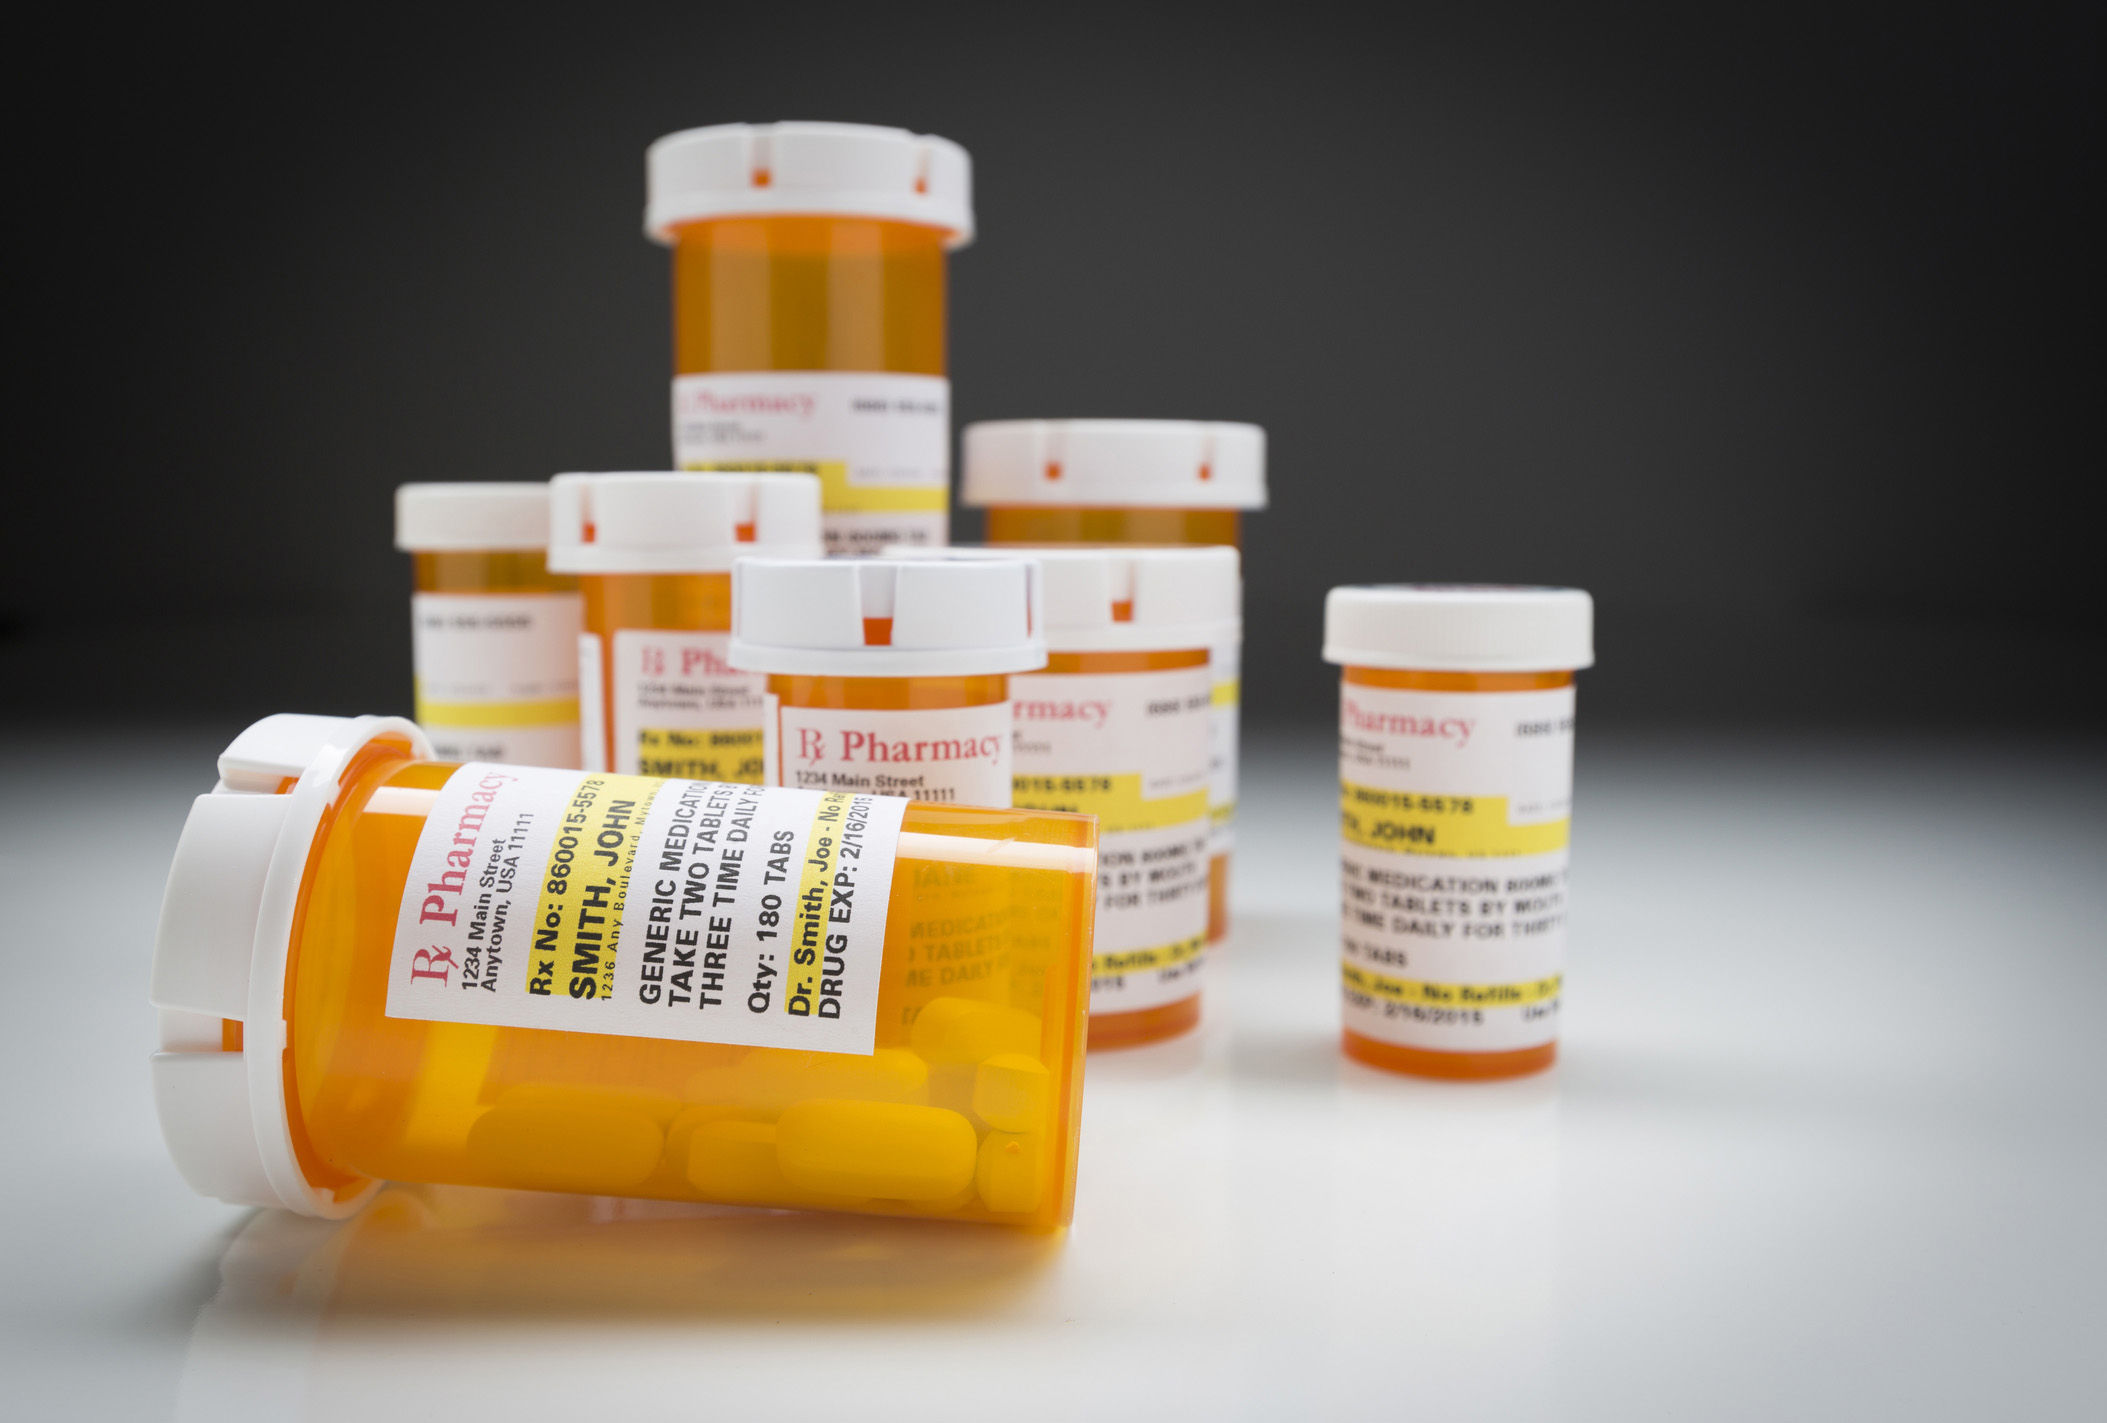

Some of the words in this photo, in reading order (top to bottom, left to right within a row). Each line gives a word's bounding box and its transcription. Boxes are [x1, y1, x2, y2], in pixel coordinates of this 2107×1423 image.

[840, 730, 1002, 765] Pharmacy
[796, 770, 827, 784] 1234
[832, 773, 870, 787] Main
[876, 774, 924, 788] Street
[546, 779, 606, 896] 860015-5578
[692, 790, 734, 854] TABLETS
[727, 798, 760, 842] DAILY
[818, 805, 842, 822] No
[840, 797, 874, 860] 2/16/2015
[1371, 820, 1435, 845] JOHN
[418, 771, 519, 927] Pharmacy
[479, 838, 506, 889] Street
[764, 830, 795, 886] TABS
[808, 838, 833, 873] Joe
[480, 900, 512, 993] Anytown,
[496, 856, 520, 893] USA
[508, 812, 534, 851] 11111
[568, 877, 617, 1000] SMITH,
[594, 799, 636, 867] JOHN
[679, 862, 710, 920] TWO
[712, 848, 744, 908] TIME
[828, 866, 858, 924] EXP:
[1368, 866, 1498, 893] MEDICATION
[468, 892, 492, 941] Main
[534, 902, 564, 952] No:
[606, 921, 625, 952] Any
[639, 879, 677, 1005] GENERIC
[756, 894, 782, 942] 180
[793, 880, 828, 966] Smith,
[1393, 915, 1456, 938] DAILY
[461, 945, 481, 991] 1234
[529, 960, 555, 996] Rx
[601, 960, 616, 1001] 1236
[668, 930, 699, 1007] TAKE
[699, 916, 732, 1010] THREE
[748, 953, 778, 1014] Qty:
[818, 934, 848, 1020] DRUG
[788, 976, 812, 1017] Dr.
